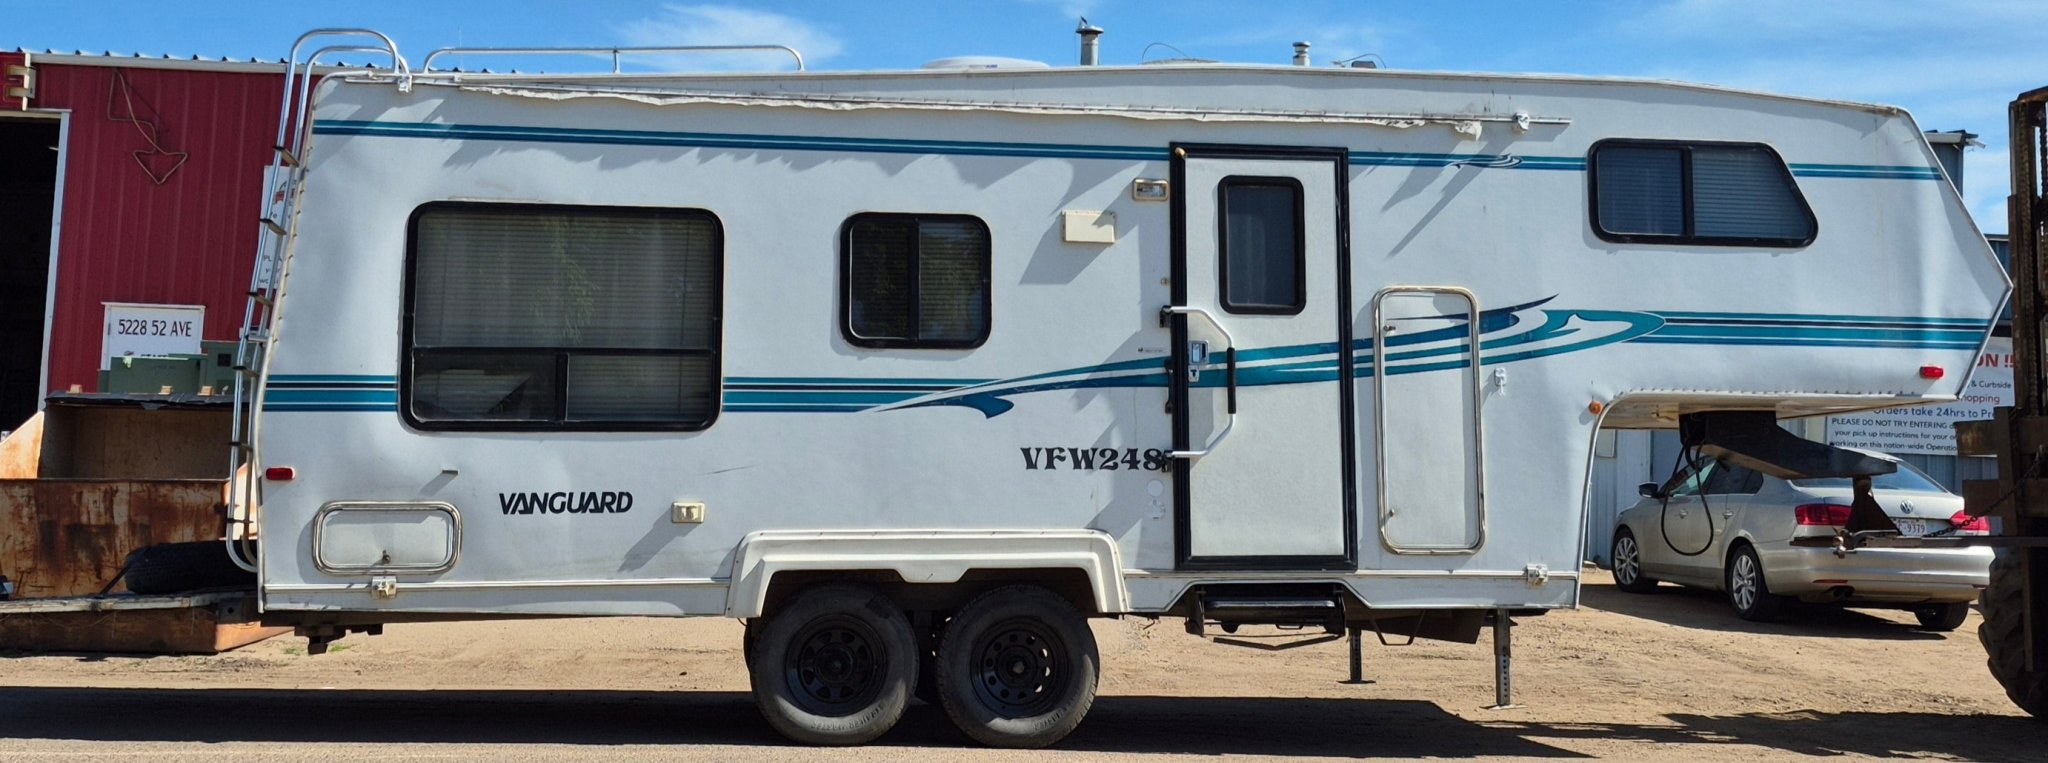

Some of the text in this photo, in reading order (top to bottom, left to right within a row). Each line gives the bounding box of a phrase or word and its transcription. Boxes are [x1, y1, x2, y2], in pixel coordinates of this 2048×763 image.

[118, 319, 192, 337] 5228 52 AVE
[1979, 380, 2012, 389] Curbside
[1911, 407, 1934, 416] take
[1936, 407, 1966, 418] 24hrs
[1968, 410, 1978, 418] to
[1831, 417, 1860, 426] PLEASE
[1862, 419, 1873, 427] DO
[1893, 420, 1908, 428] TRY
[1909, 421, 1948, 430] ENTERING
[1852, 429, 1867, 437] pick
[1879, 431, 1919, 439] instructions
[1869, 440, 1882, 448] this
[499, 491, 633, 515] VANGUARD
